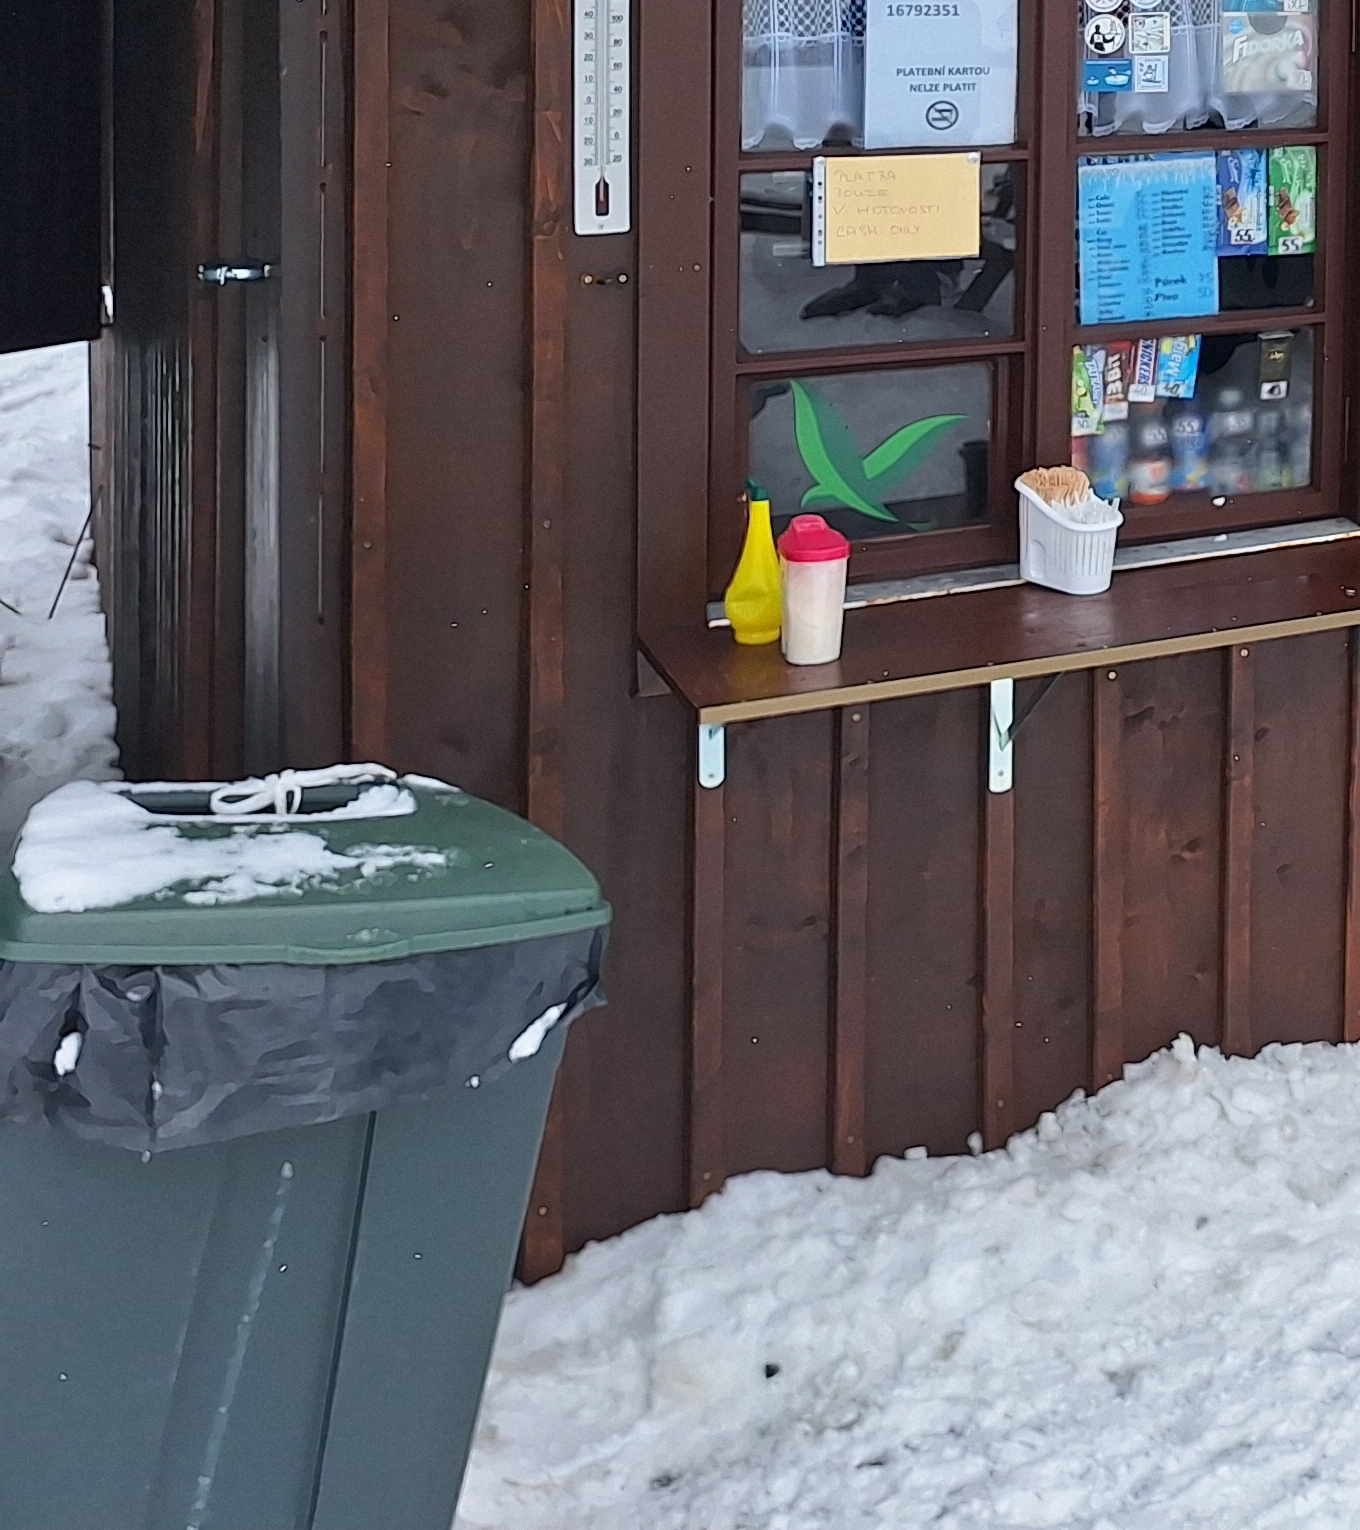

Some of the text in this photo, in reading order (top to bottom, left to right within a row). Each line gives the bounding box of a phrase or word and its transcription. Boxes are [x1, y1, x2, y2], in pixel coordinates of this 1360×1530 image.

[887, 3, 960, 17] 16792351
[583, 53, 593, 61] 20
[896, 65, 990, 77] PLATEBNÍ KARTOU
[909, 81, 977, 93] NELZE PLATIT
[583, 137, 593, 145] 20
[832, 205, 846, 215] V
[836, 224, 921, 237] CASH ONLY
